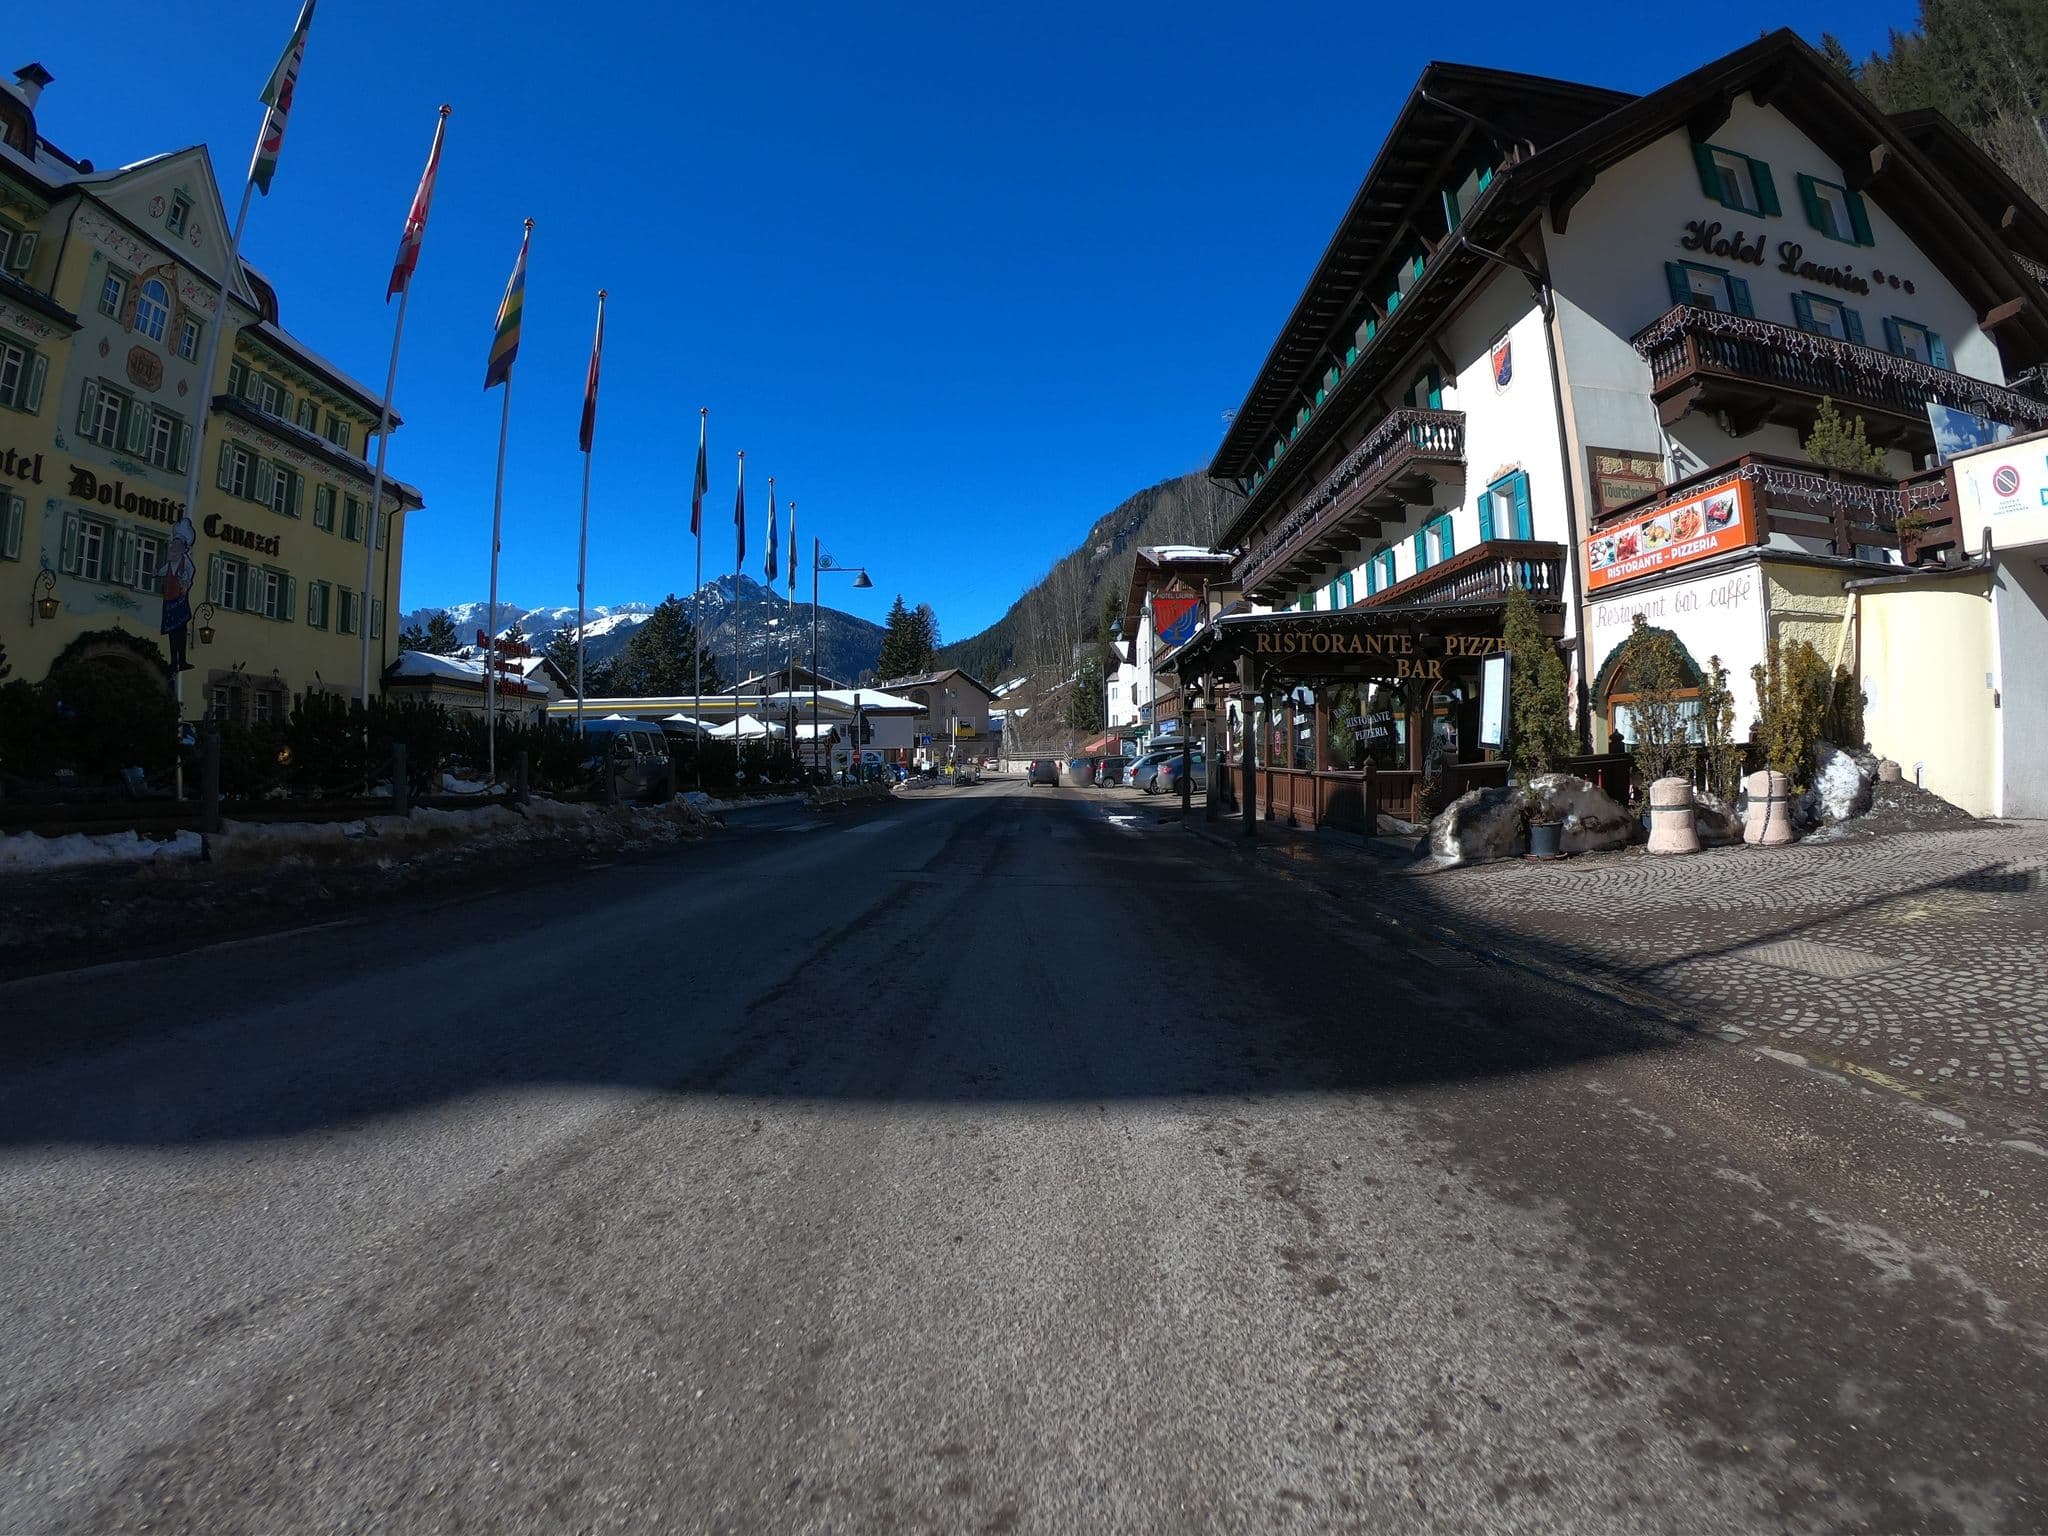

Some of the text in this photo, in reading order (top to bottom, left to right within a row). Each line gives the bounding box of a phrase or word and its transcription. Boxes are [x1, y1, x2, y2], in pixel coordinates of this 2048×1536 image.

[1681, 219, 1870, 296] Hotel Laurin
[68, 463, 186, 526] Dolomiti
[203, 513, 281, 557] Canazei
[1607, 554, 1662, 578] RISTORANTE
[1672, 537, 1718, 559] PIZZERIA
[1596, 597, 1665, 628] Restaurant
[1675, 590, 1699, 614] bar
[1256, 632, 1415, 656] RISTORANTE
[1397, 658, 1443, 680] BAR
[1347, 711, 1391, 727] RISTORANTE
[1355, 728, 1388, 740] PIZZERIA
